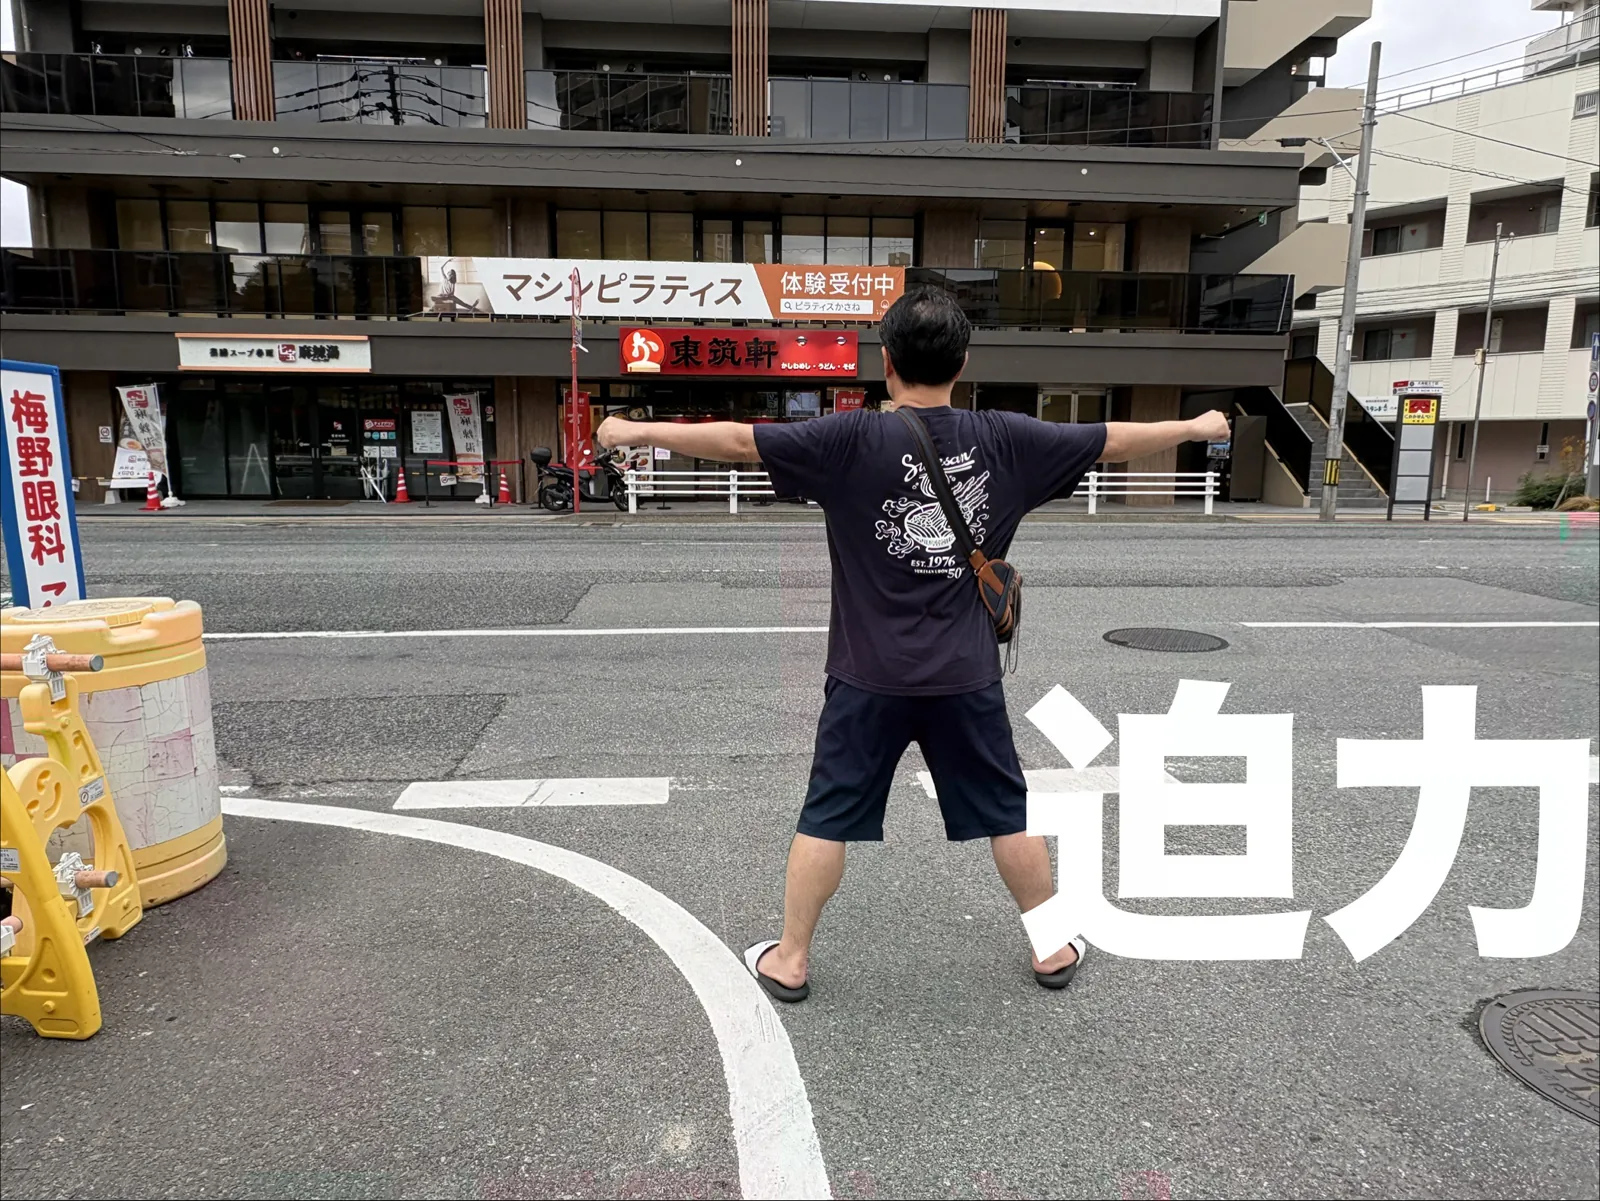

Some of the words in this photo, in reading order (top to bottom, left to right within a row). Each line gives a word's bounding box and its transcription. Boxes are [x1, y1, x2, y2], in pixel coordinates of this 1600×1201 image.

[502, 272, 743, 307] マシンピラティス
[780, 271, 894, 296] 体験受付中
[795, 301, 861, 312] ピラティスかさね
[670, 335, 779, 368] 東筑軒
[10, 389, 65, 566] 梅野眼科
[910, 559, 927, 568] EST.
[927, 554, 956, 568] 1976
